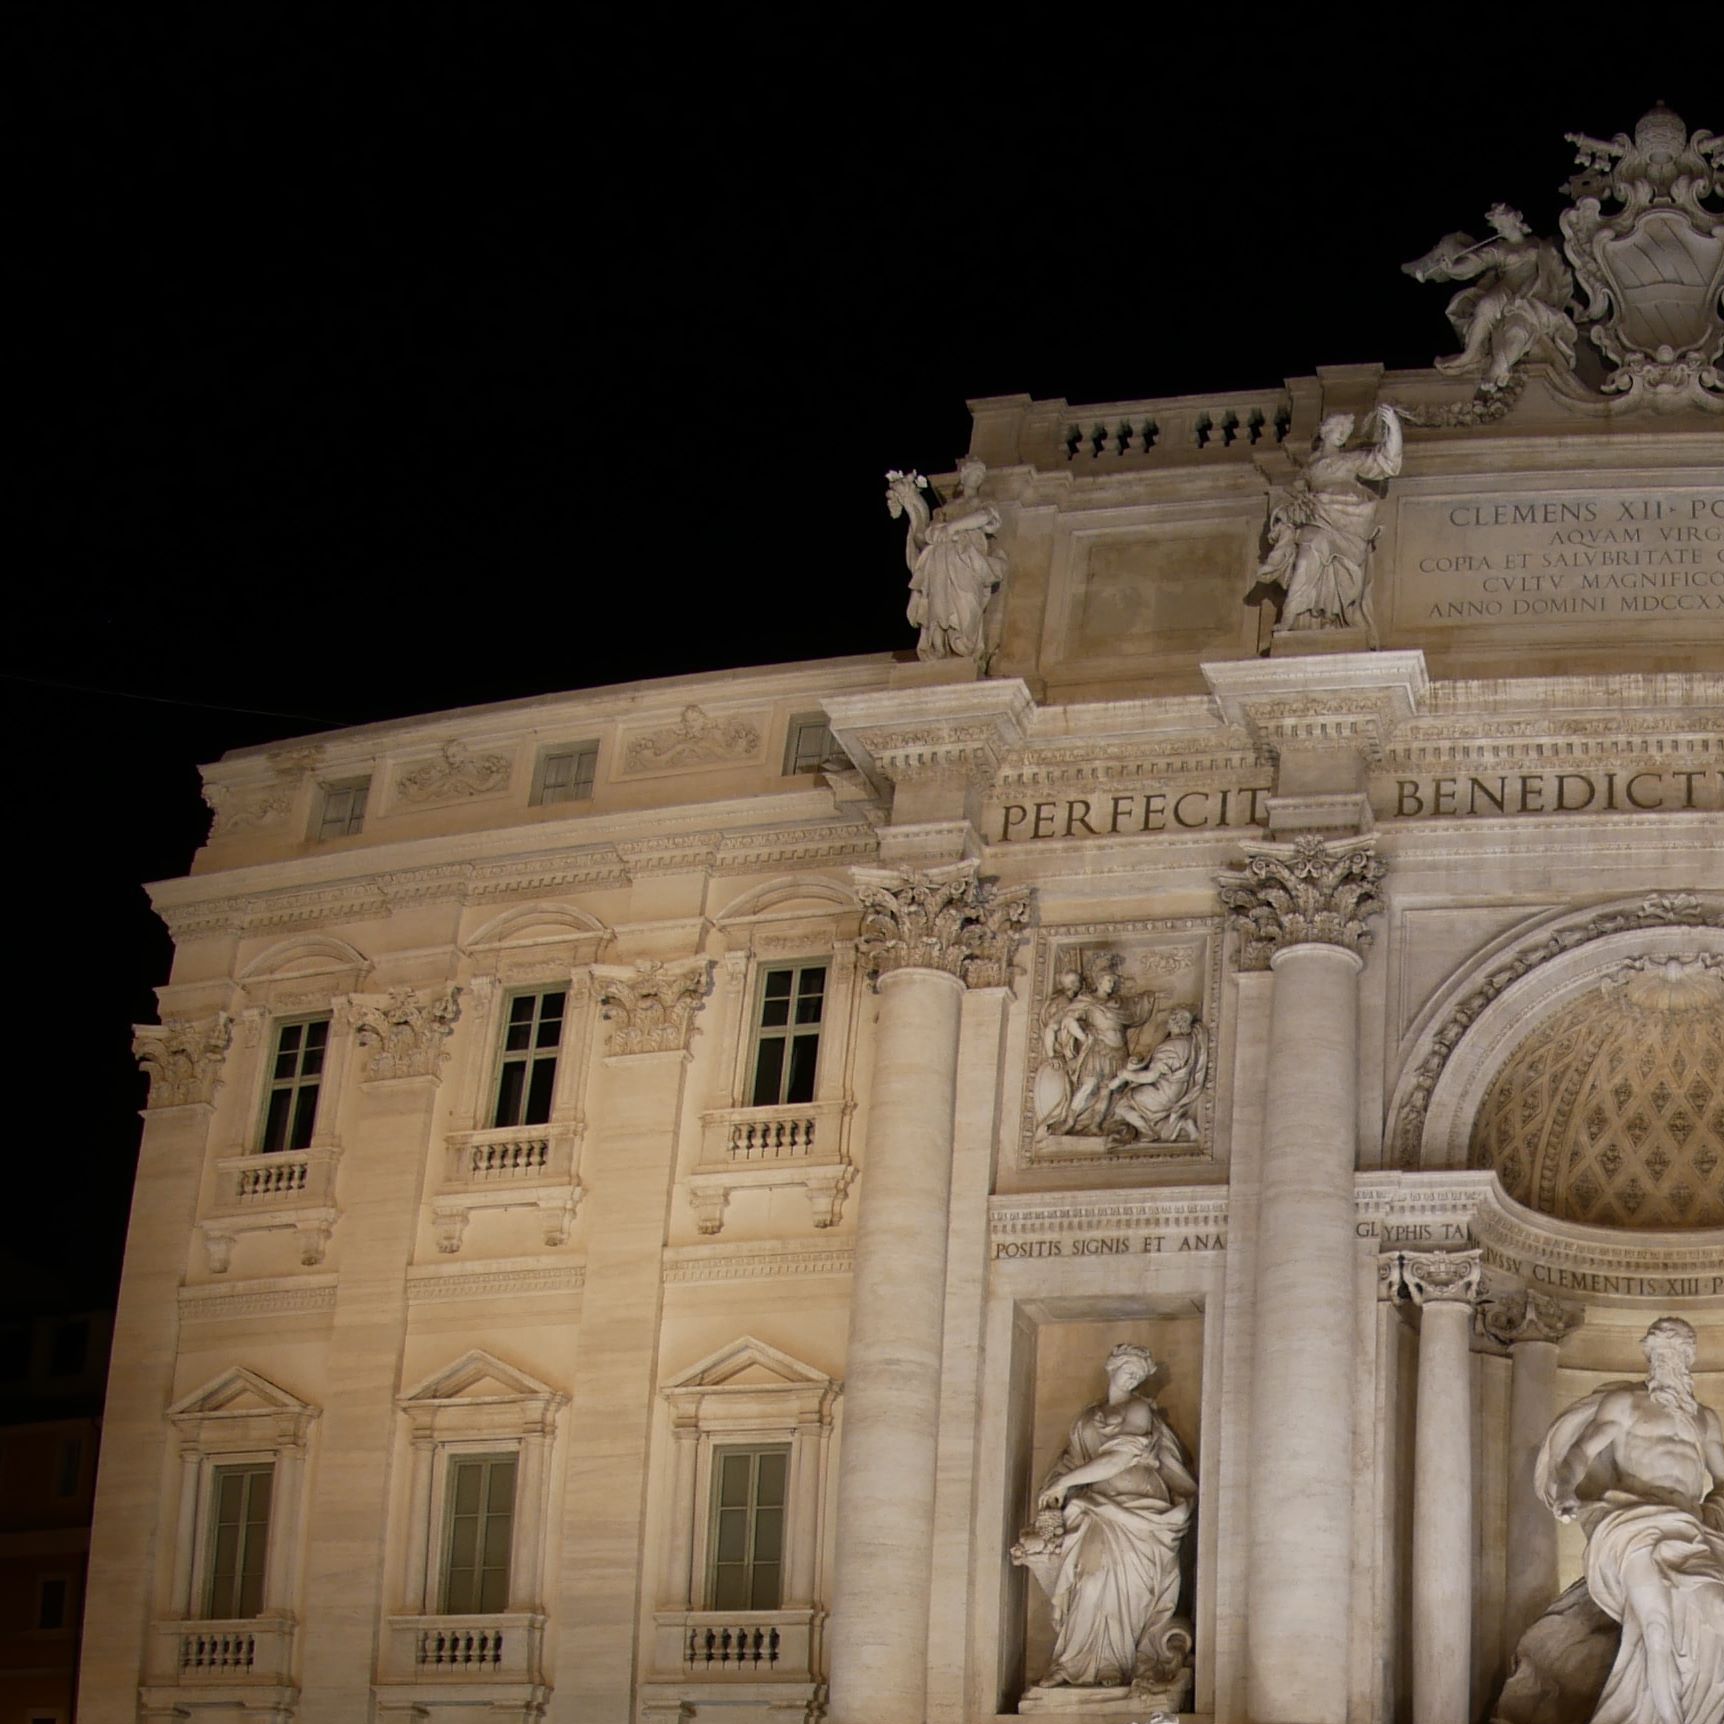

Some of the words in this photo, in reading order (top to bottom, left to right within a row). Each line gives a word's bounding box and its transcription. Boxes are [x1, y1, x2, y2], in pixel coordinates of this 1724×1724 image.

[1449, 502, 1597, 527] CLEMENS
[1549, 528, 1642, 548] AQVAM
[1419, 556, 1491, 573] COPIA
[1504, 554, 1532, 570] ET
[1542, 549, 1701, 568] SALVBRITATE
[1483, 575, 1564, 593] CVLTV
[1428, 600, 1503, 618] ANNO
[1513, 597, 1605, 616] DOMINI
[998, 786, 1273, 843] PERFECIT
[995, 1241, 1062, 1259] POSITIS
[1072, 1238, 1130, 1256] SIGNIS
[1143, 1237, 1166, 1253] ET
[1178, 1235, 1225, 1251] ANA
[1532, 1263, 1656, 1295] CLEMENTIS
